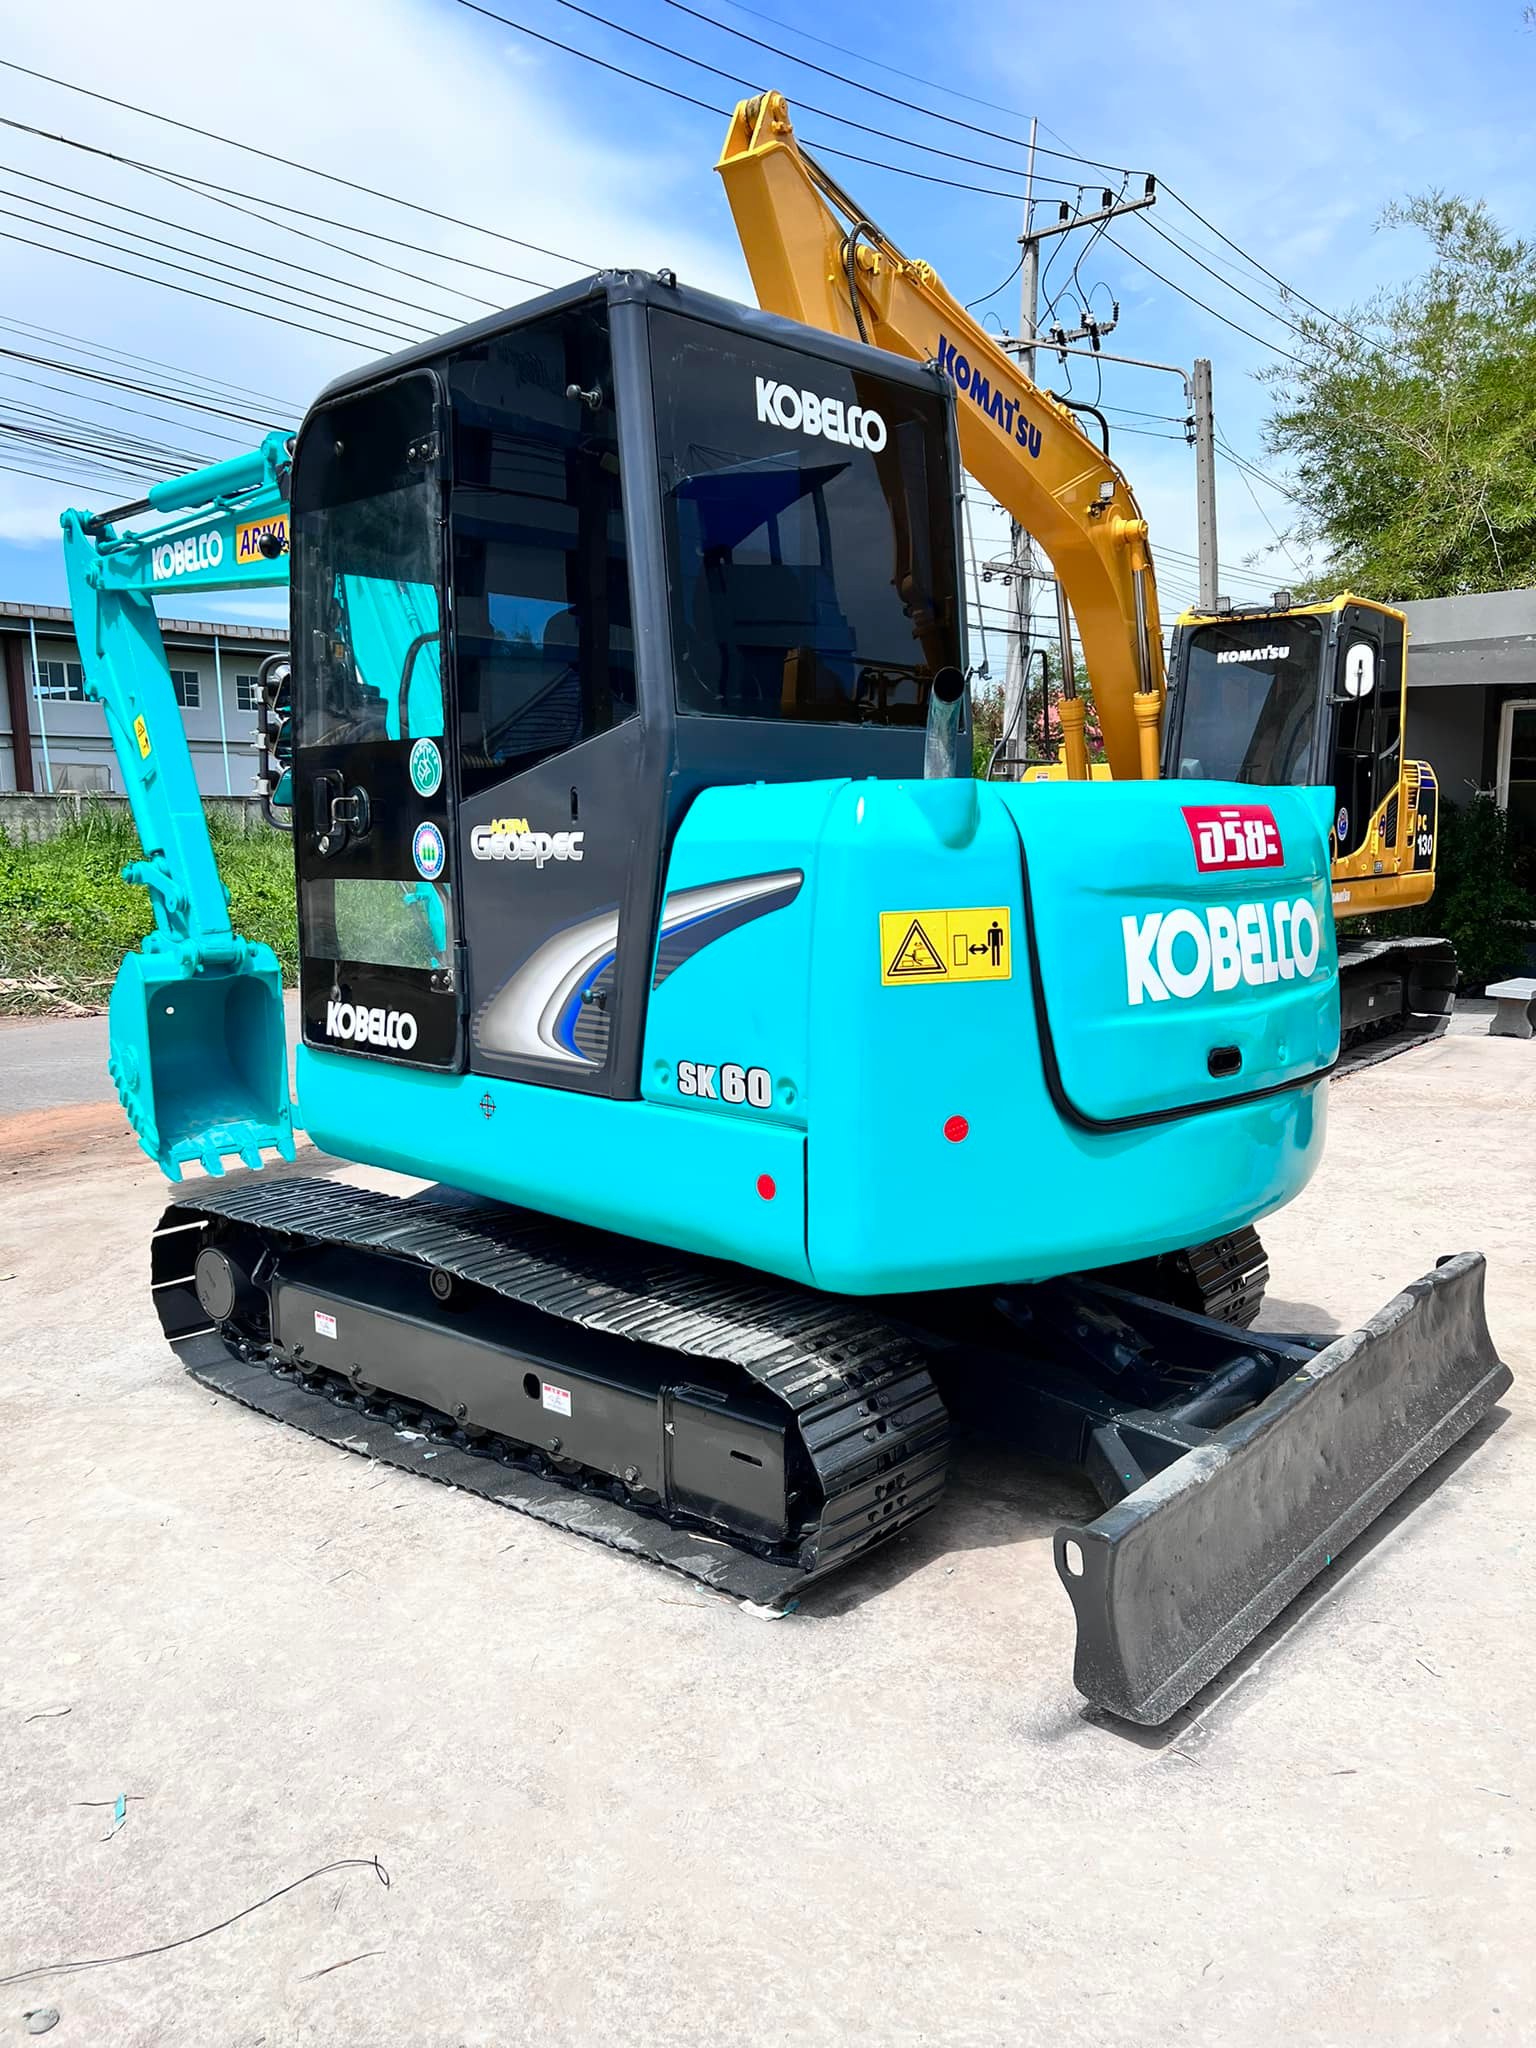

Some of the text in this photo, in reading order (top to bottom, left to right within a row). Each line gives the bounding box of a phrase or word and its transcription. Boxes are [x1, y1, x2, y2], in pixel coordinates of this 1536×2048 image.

[755, 376, 887, 453] KOBELCO
[938, 334, 1042, 459] KOMATSU
[151, 530, 223, 581] KOBELCO
[1216, 645, 1290, 664] KOMATSU
[1417, 834, 1433, 856] 130
[1121, 898, 1320, 1006] KOBELCO
[326, 1001, 418, 1051] KOBELCO
